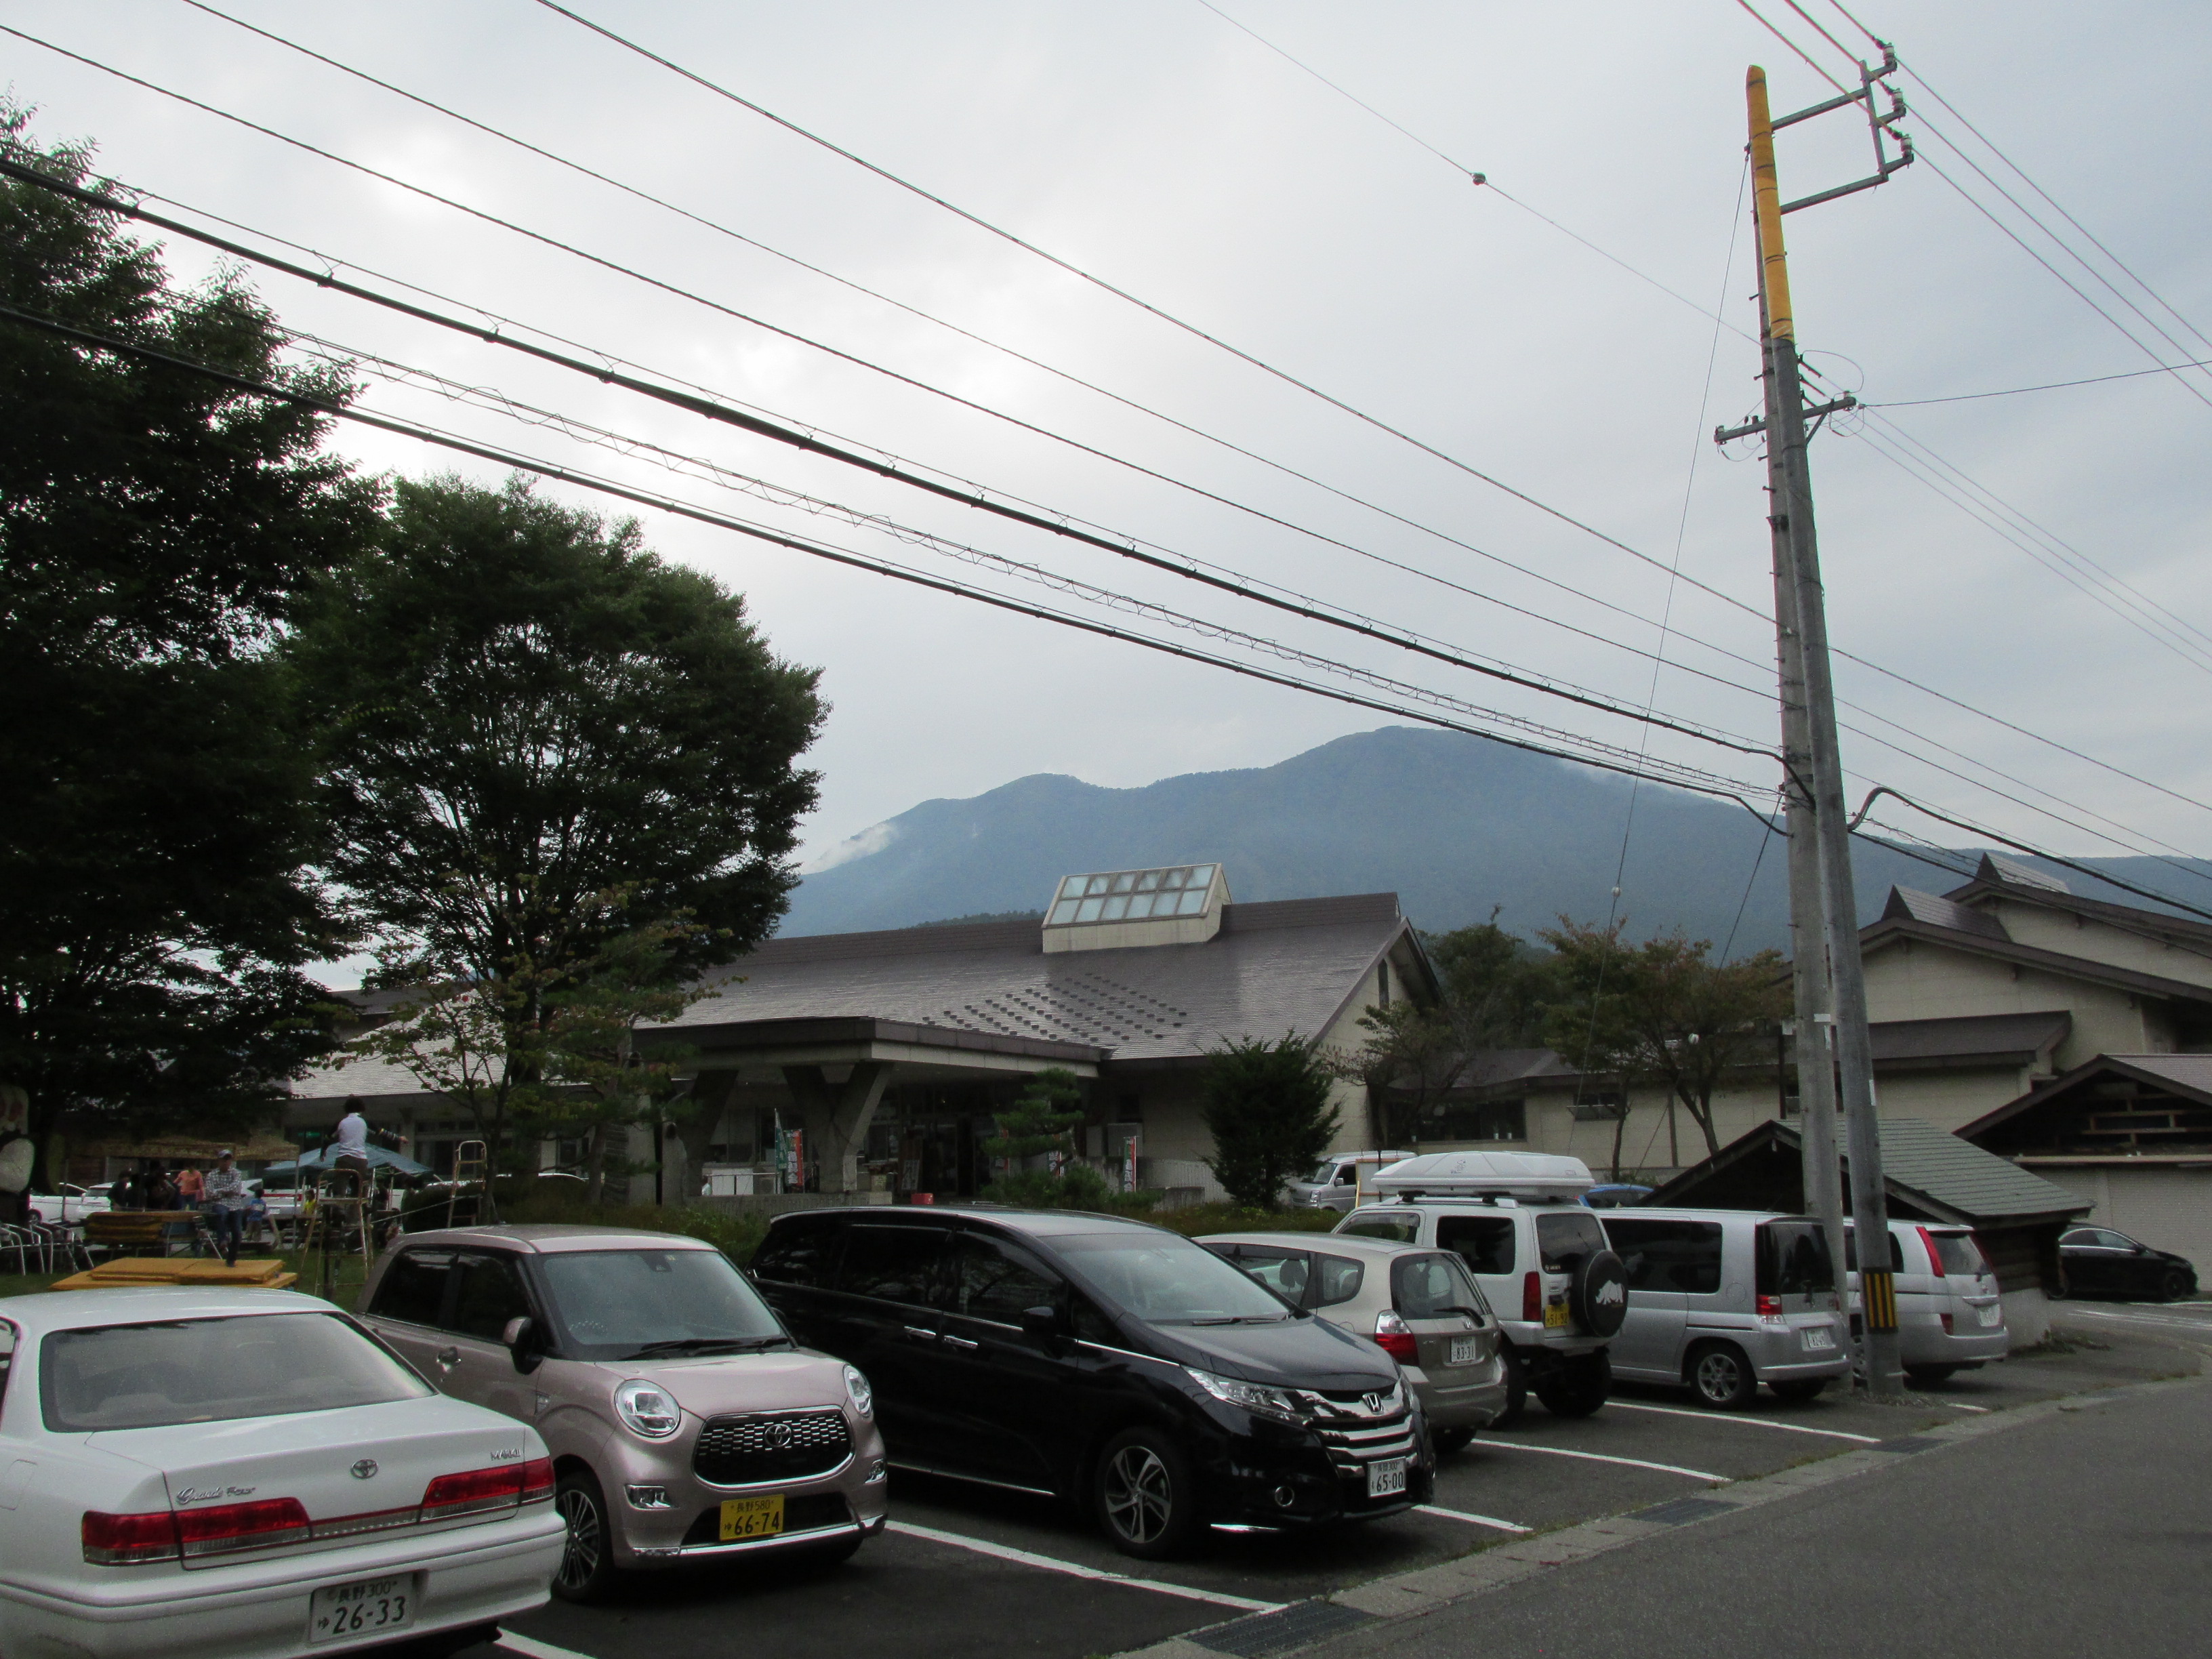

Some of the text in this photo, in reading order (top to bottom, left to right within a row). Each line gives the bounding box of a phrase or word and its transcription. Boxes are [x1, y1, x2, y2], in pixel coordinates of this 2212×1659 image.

[1456, 1345, 1474, 1359] 83-31
[1376, 1471, 1404, 1492] 65-00
[176, 1486, 224, 1505] Grande
[734, 1511, 780, 1535] 66-74
[333, 1595, 406, 1634] 26-33
